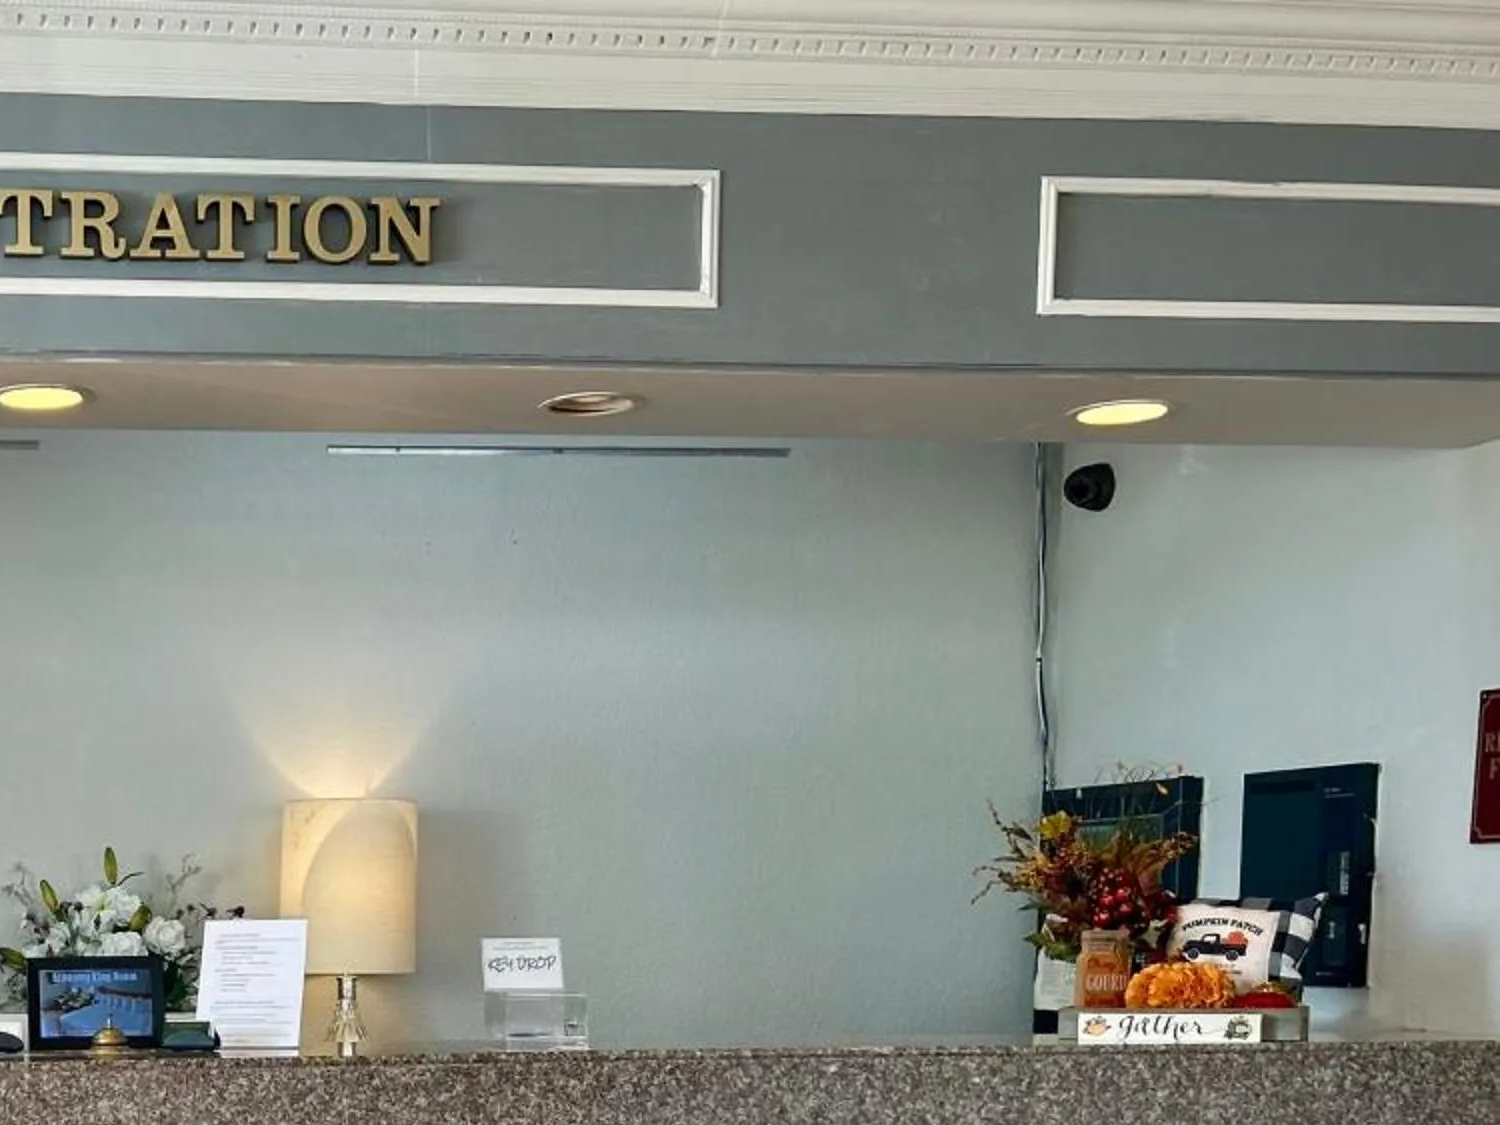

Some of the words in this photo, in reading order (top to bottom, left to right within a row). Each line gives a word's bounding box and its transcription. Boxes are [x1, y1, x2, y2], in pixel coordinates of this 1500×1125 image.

[1182, 917, 1229, 931] PUMPKIN
[1230, 919, 1264, 937] PATCH
[515, 955, 557, 971] DROP
[1119, 1015, 1203, 1041] gather
